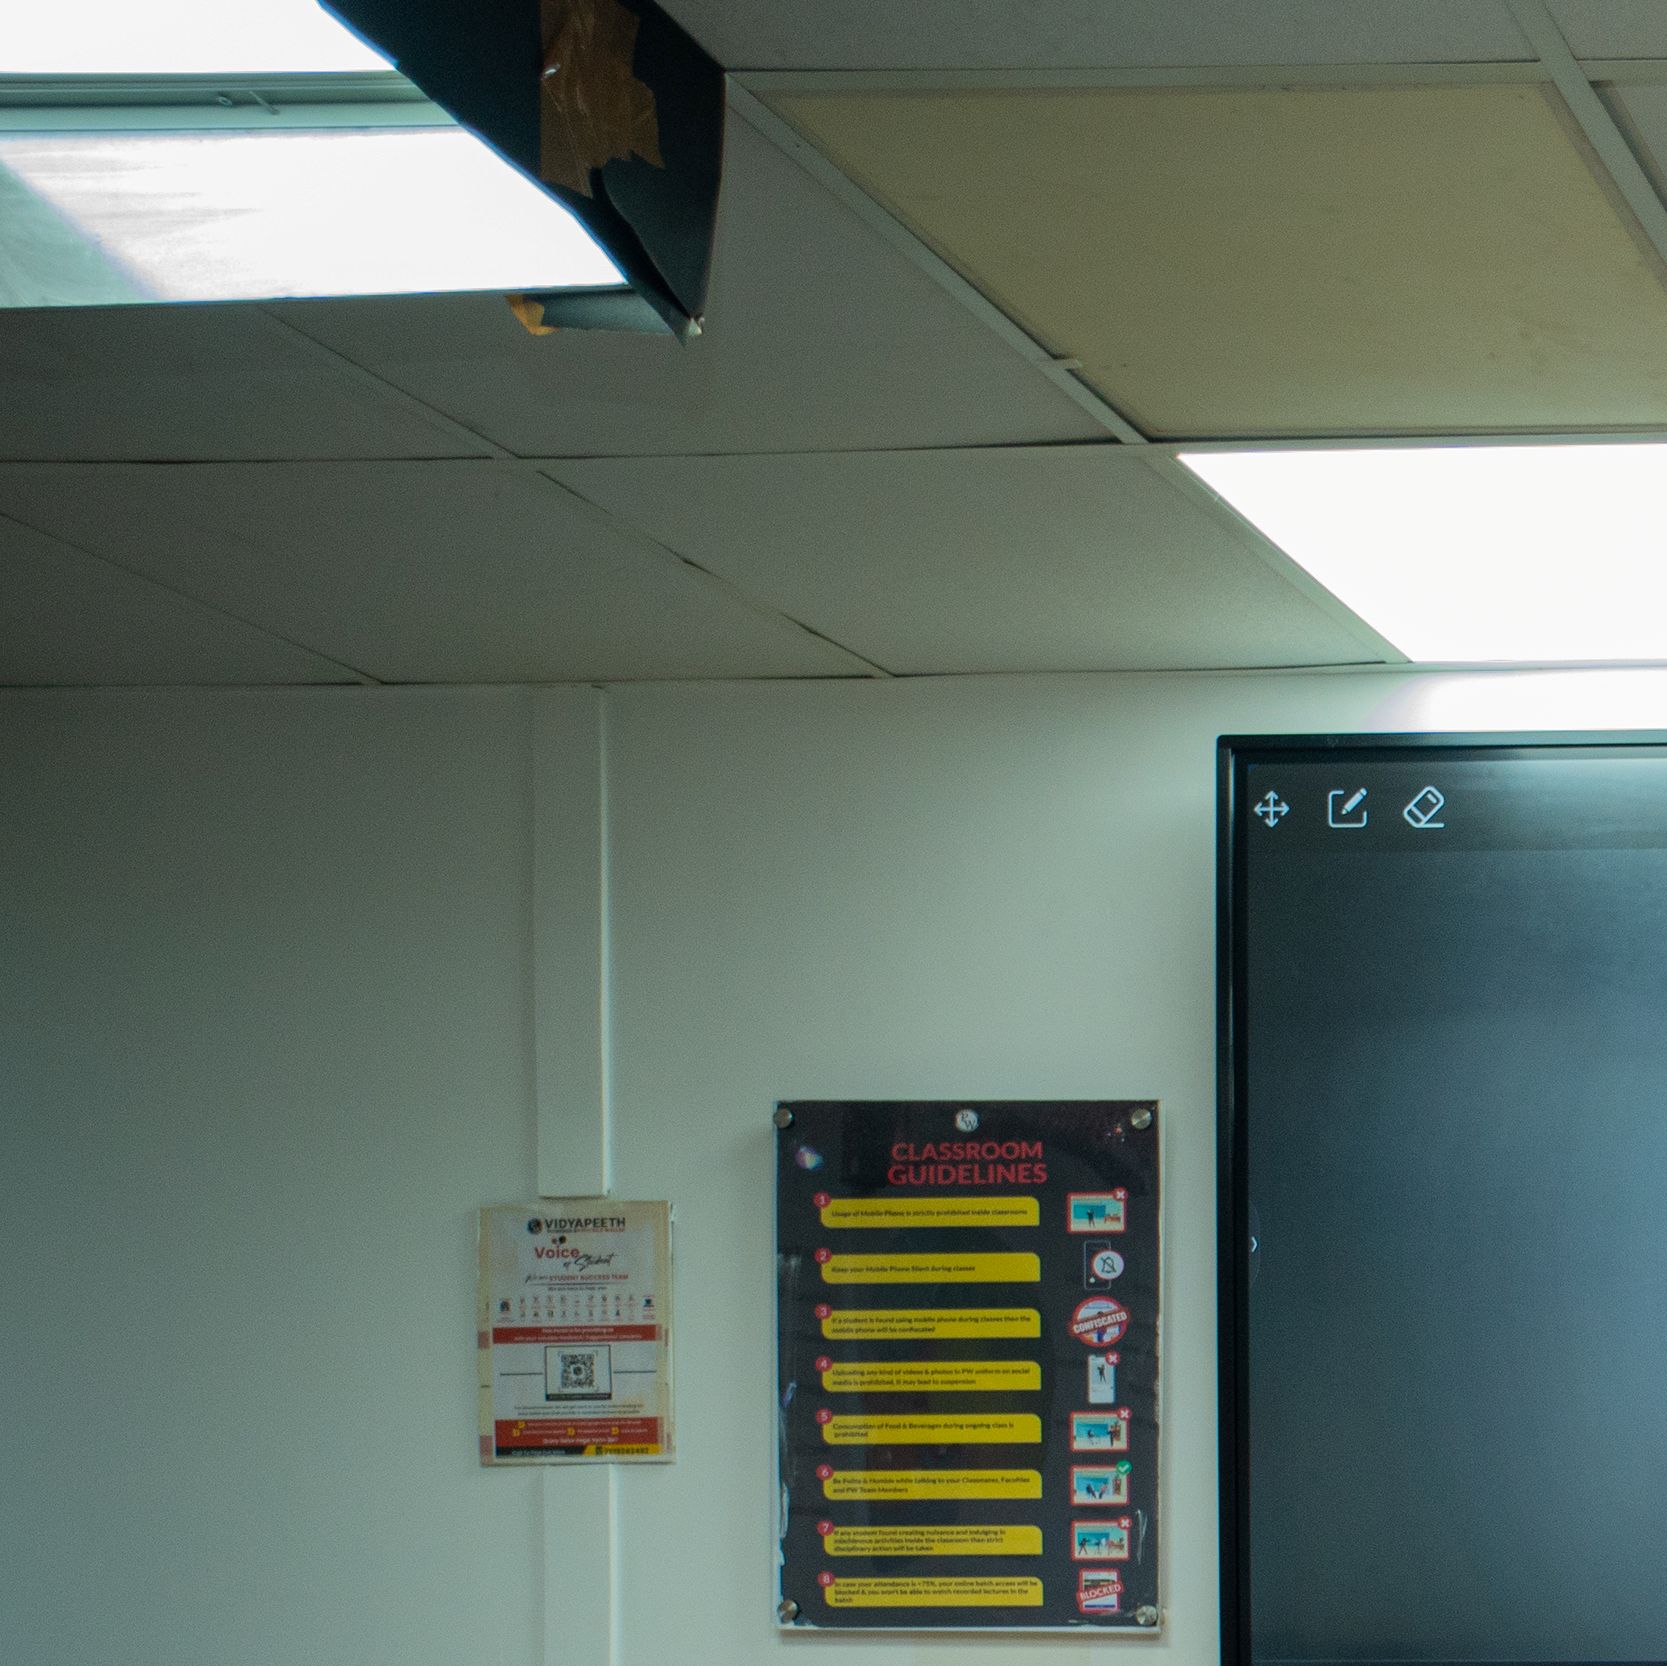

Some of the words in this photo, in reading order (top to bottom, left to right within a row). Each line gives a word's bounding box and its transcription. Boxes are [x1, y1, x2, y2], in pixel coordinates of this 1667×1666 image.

[891, 1141, 1043, 1161] CLASSROOM
[887, 1162, 1048, 1185] GUIDELINES
[820, 1196, 825, 1204] 1
[544, 1217, 626, 1229] VIDYAPEETH
[535, 1246, 580, 1259] Voice
[820, 1252, 826, 1261] 2
[575, 1253, 616, 1272] Student
[821, 1308, 827, 1316] 3
[1074, 1312, 1128, 1334] CONFISCATED
[821, 1360, 828, 1369] 4
[821, 1412, 828, 1421] 5
[822, 1469, 829, 1477] 6
[823, 1524, 830, 1532] 7
[823, 1575, 830, 1584] 8
[1080, 1583, 1121, 1601] BLOCKED
